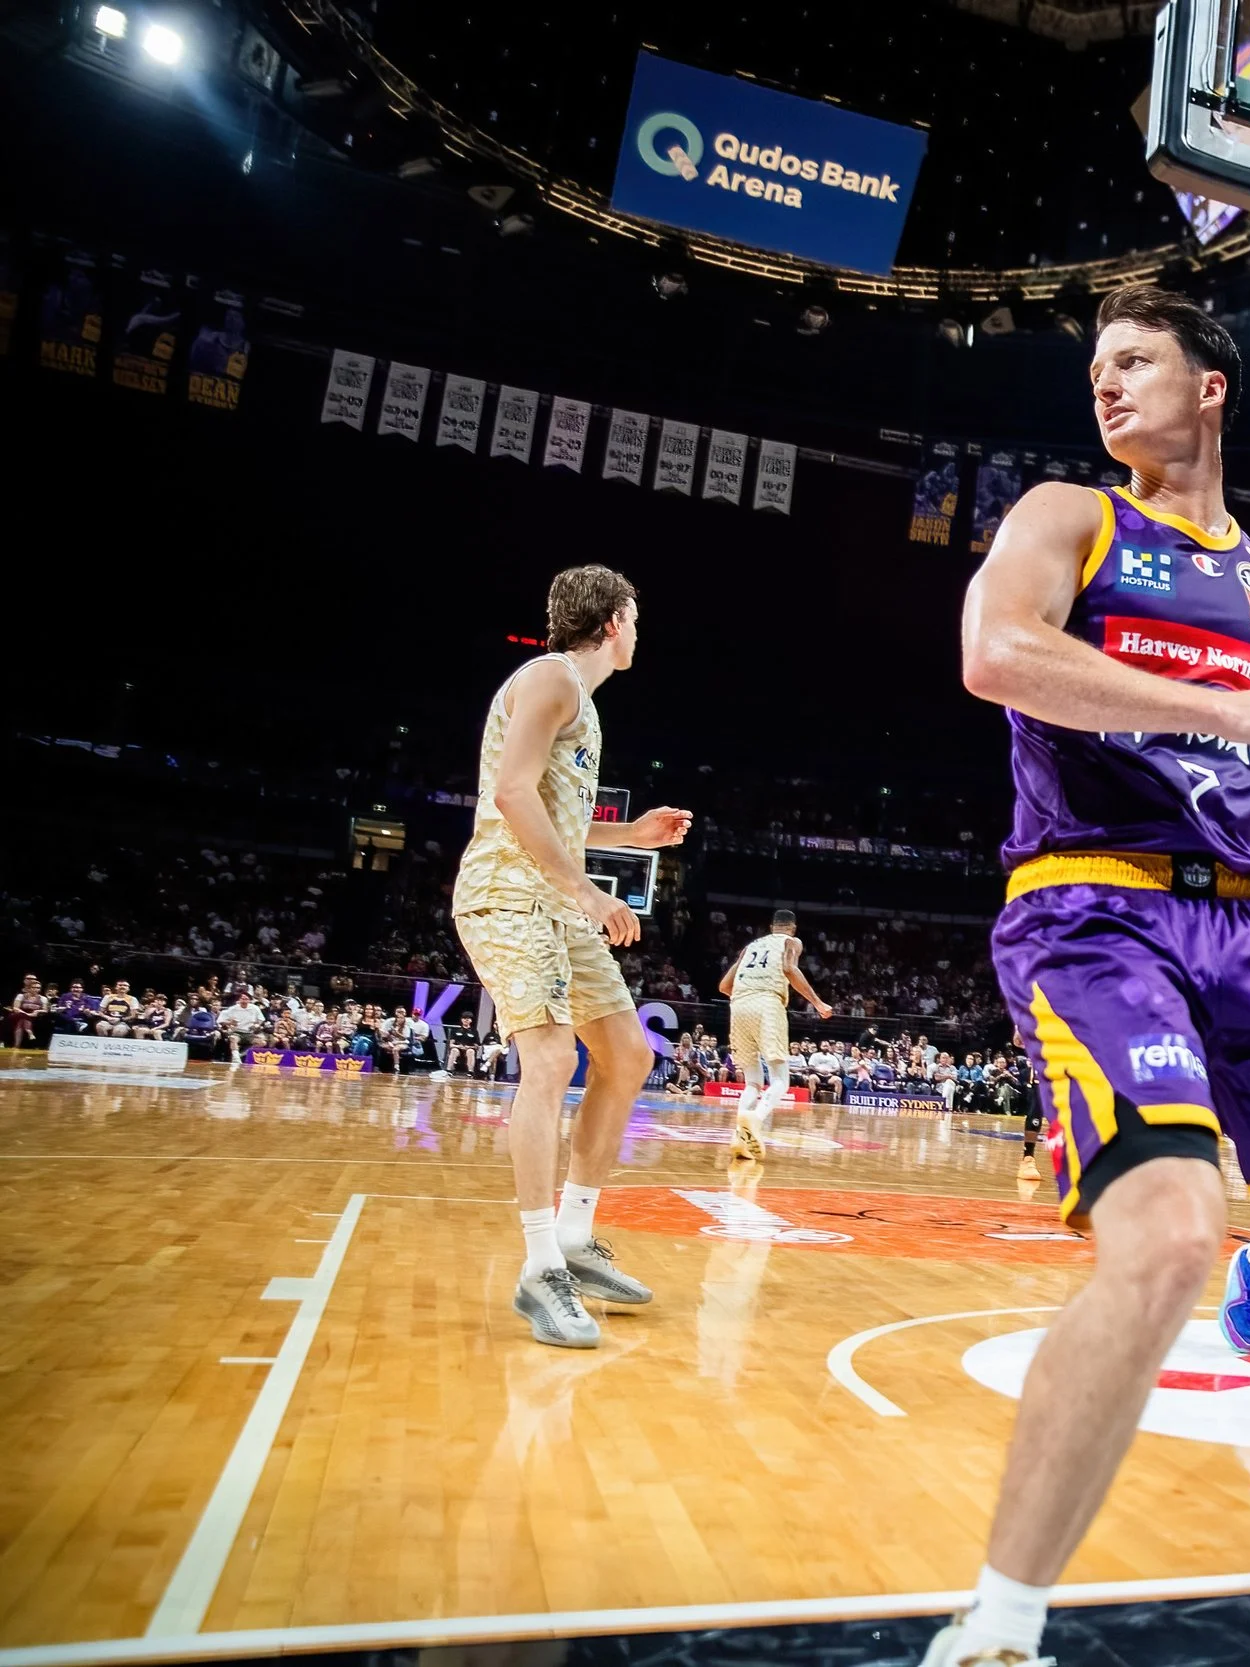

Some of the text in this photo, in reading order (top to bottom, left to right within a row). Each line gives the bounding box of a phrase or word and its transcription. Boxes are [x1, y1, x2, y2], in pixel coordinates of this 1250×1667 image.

[714, 133, 820, 181] Qudos
[821, 160, 900, 202] Bank
[707, 165, 803, 208] Arena
[189, 371, 241, 404] DEAN
[1120, 575, 1171, 591] HOSTPLUS
[1119, 631, 1203, 666] Harvey
[1177, 758, 1220, 815] 7
[58, 1039, 98, 1050] SALON
[103, 1043, 180, 1055] WAREHOUSE
[849, 1094, 945, 1110] BUILT FOR SYDNEY
